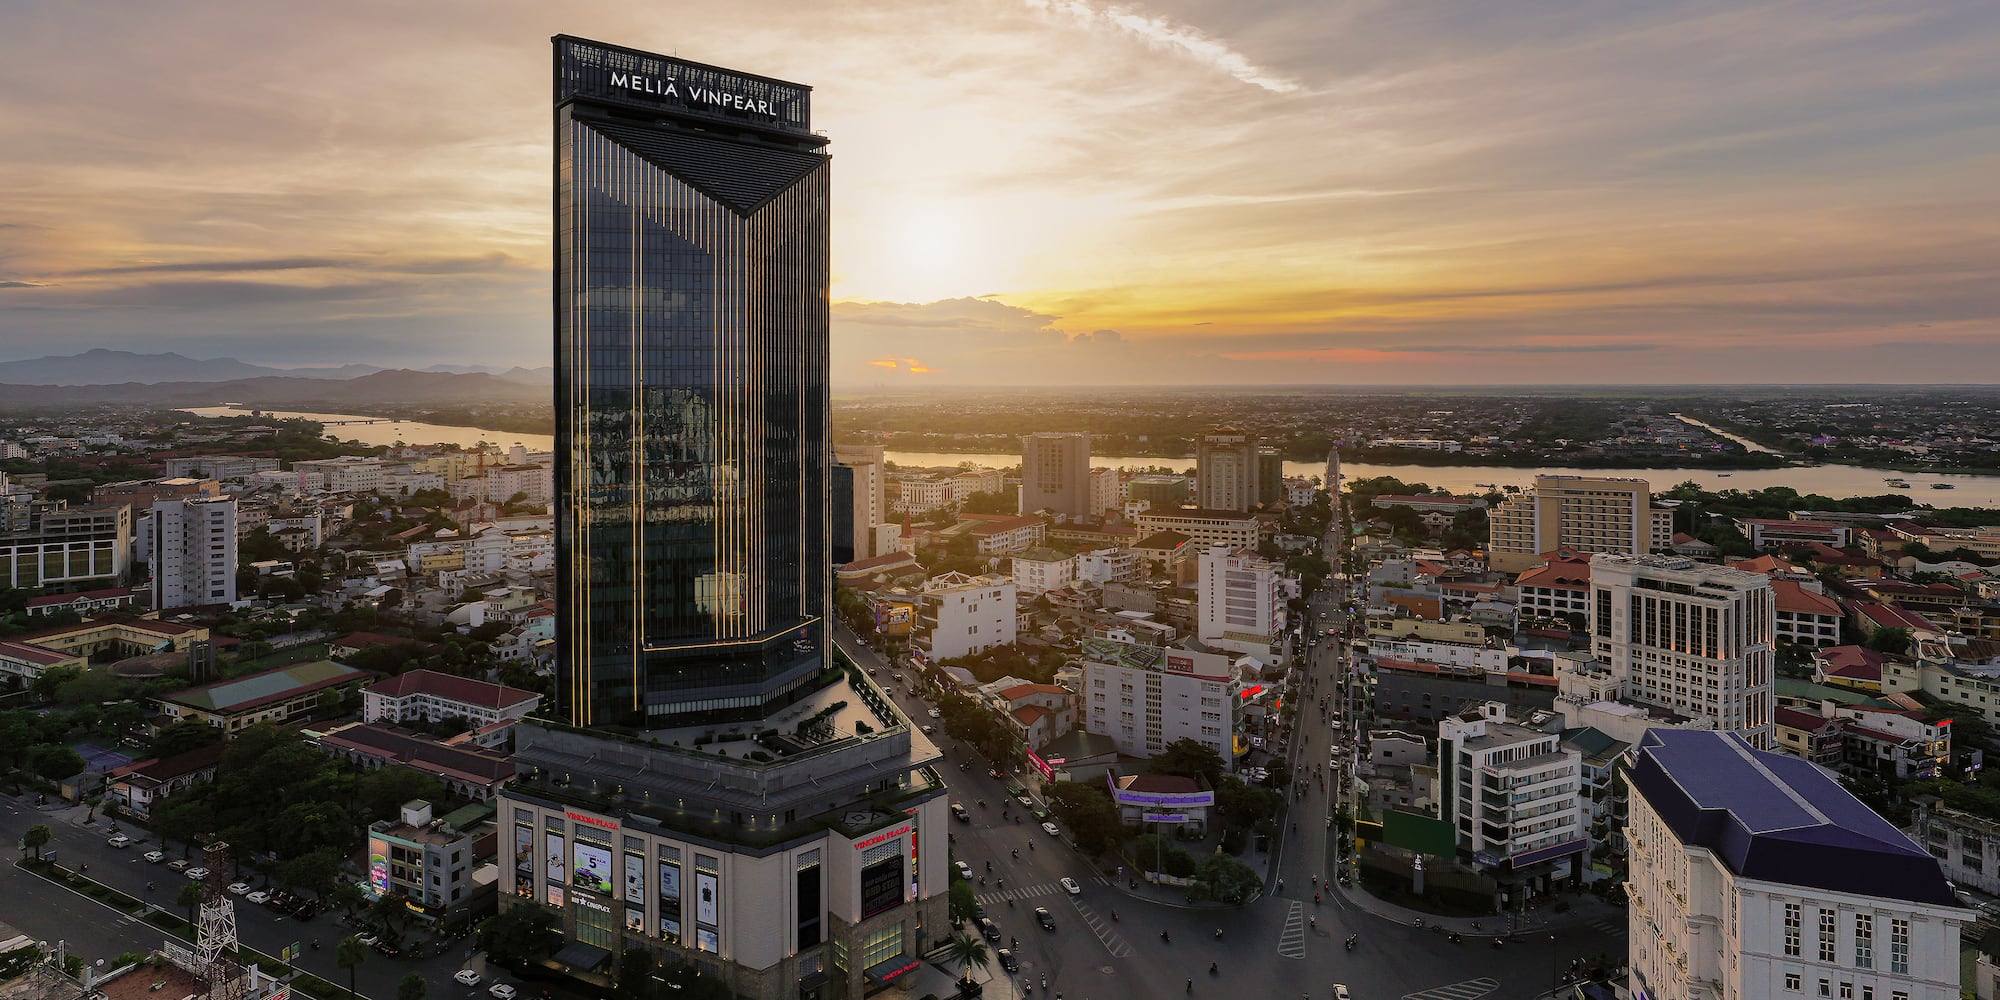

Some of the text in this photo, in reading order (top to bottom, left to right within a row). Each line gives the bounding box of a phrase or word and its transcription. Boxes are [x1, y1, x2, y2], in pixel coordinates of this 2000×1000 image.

[610, 71, 777, 116] MELIÃ VINPEARL
[595, 818, 619, 830] PLAZA
[589, 857, 597, 868] 5
